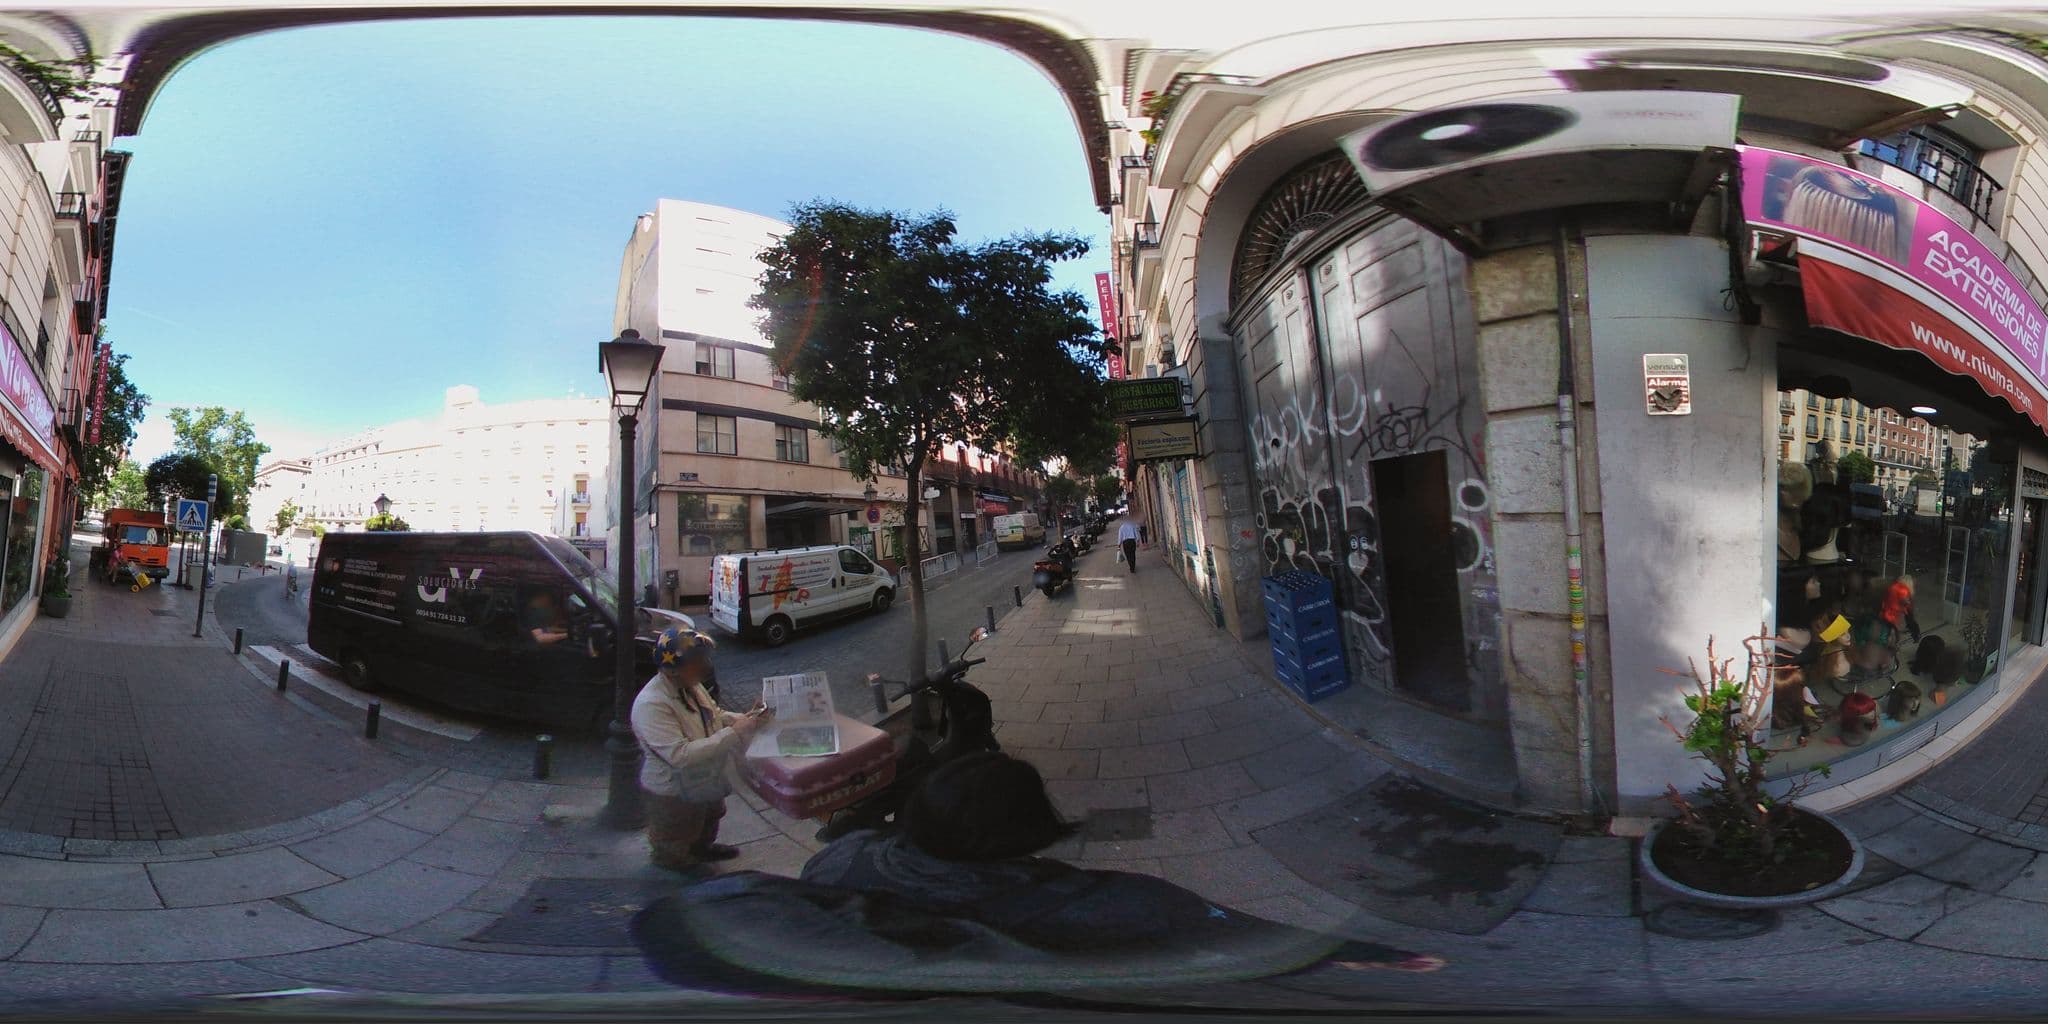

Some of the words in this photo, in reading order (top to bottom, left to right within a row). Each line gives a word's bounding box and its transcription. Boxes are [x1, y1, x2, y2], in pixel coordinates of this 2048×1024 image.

[1924, 248, 2040, 359] EXTENSIONES
[1927, 230, 2025, 322] ACADEMIA
[2022, 311, 2041, 340] DE
[1099, 279, 1111, 318] PETIT
[1105, 322, 1121, 379] PACE
[98, 350, 108, 381] PETIT
[1648, 378, 1688, 387] Alarma
[1910, 320, 2033, 412] www.niuma.com
[93, 384, 103, 425] PALACE
[418, 575, 477, 590] SOLUCIONES
[809, 787, 850, 809] JUST
